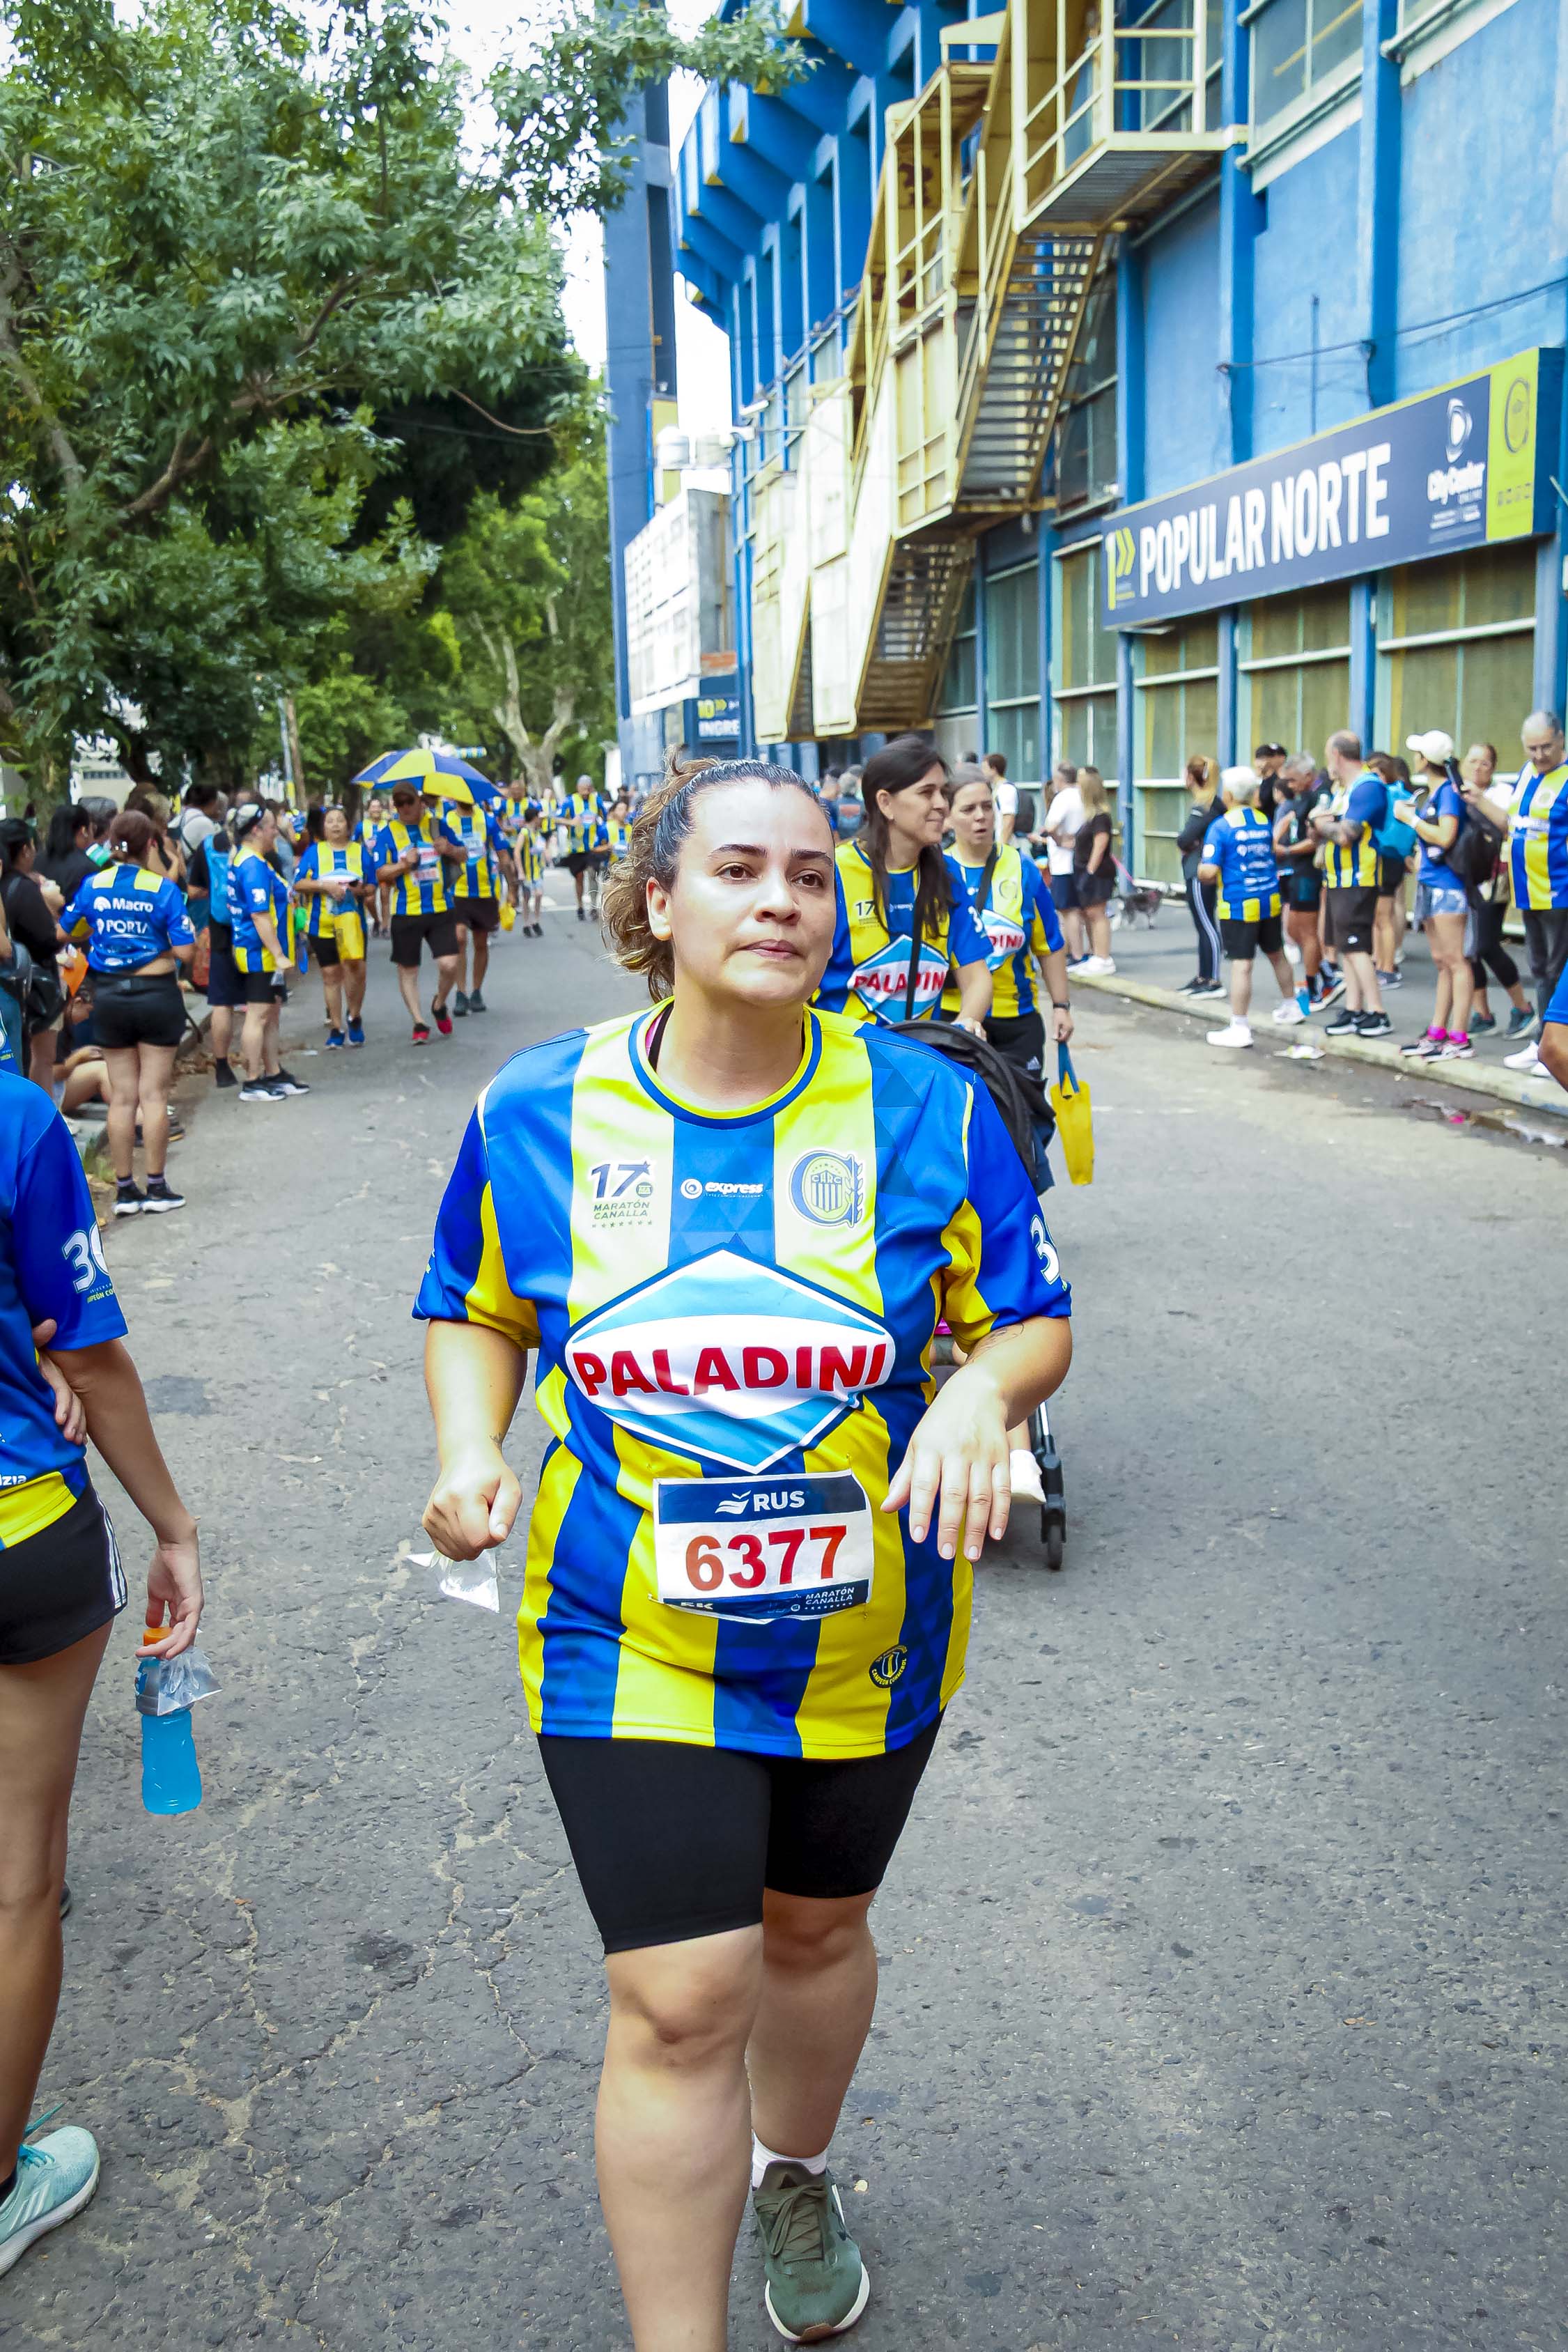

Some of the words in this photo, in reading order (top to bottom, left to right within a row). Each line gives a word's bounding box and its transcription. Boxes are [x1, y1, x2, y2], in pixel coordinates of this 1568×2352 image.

[1140, 488, 1266, 598] POPULAR
[1271, 442, 1391, 564] NORTE
[112, 897, 153, 913] Macro
[855, 900, 876, 916] 17
[591, 1161, 651, 1198] 17
[705, 1182, 764, 1193] express
[593, 1200, 650, 1212] MARATÓN
[593, 1209, 648, 1220] CANALLA
[572, 1343, 887, 1396] PALADINI
[753, 1491, 805, 1512] RUS
[685, 1525, 847, 1591] 6377
[805, 1586, 855, 1600] MARATÓN
[805, 1595, 853, 1605] CANALLA
